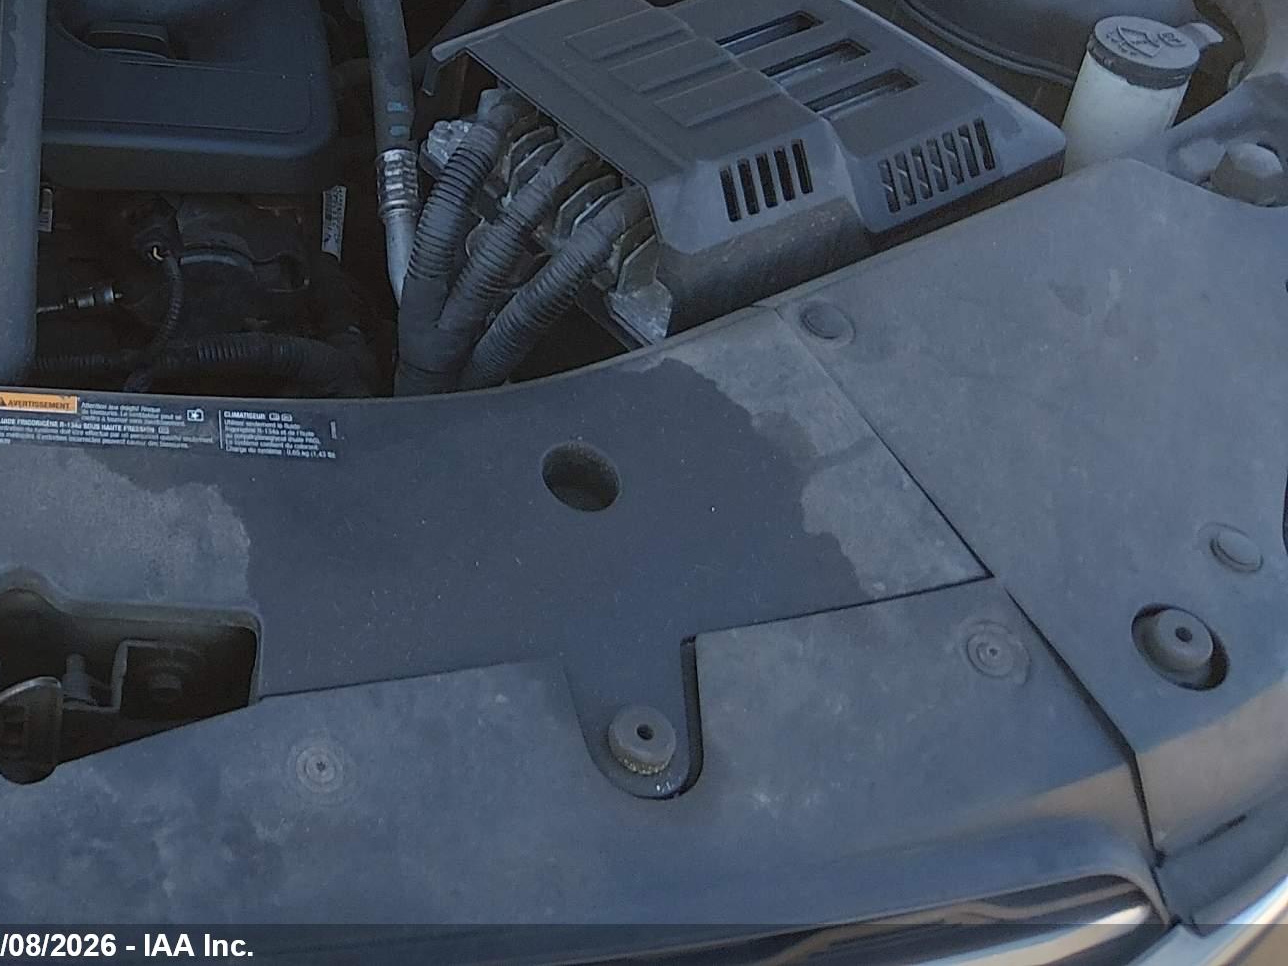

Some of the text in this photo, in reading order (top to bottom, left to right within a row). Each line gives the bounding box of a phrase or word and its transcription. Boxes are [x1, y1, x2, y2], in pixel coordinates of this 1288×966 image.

[7, 399, 70, 409] AVERTISSEMENT
[223, 411, 266, 420] CLIMATISEUR
[101, 423, 122, 431] HAUTE
